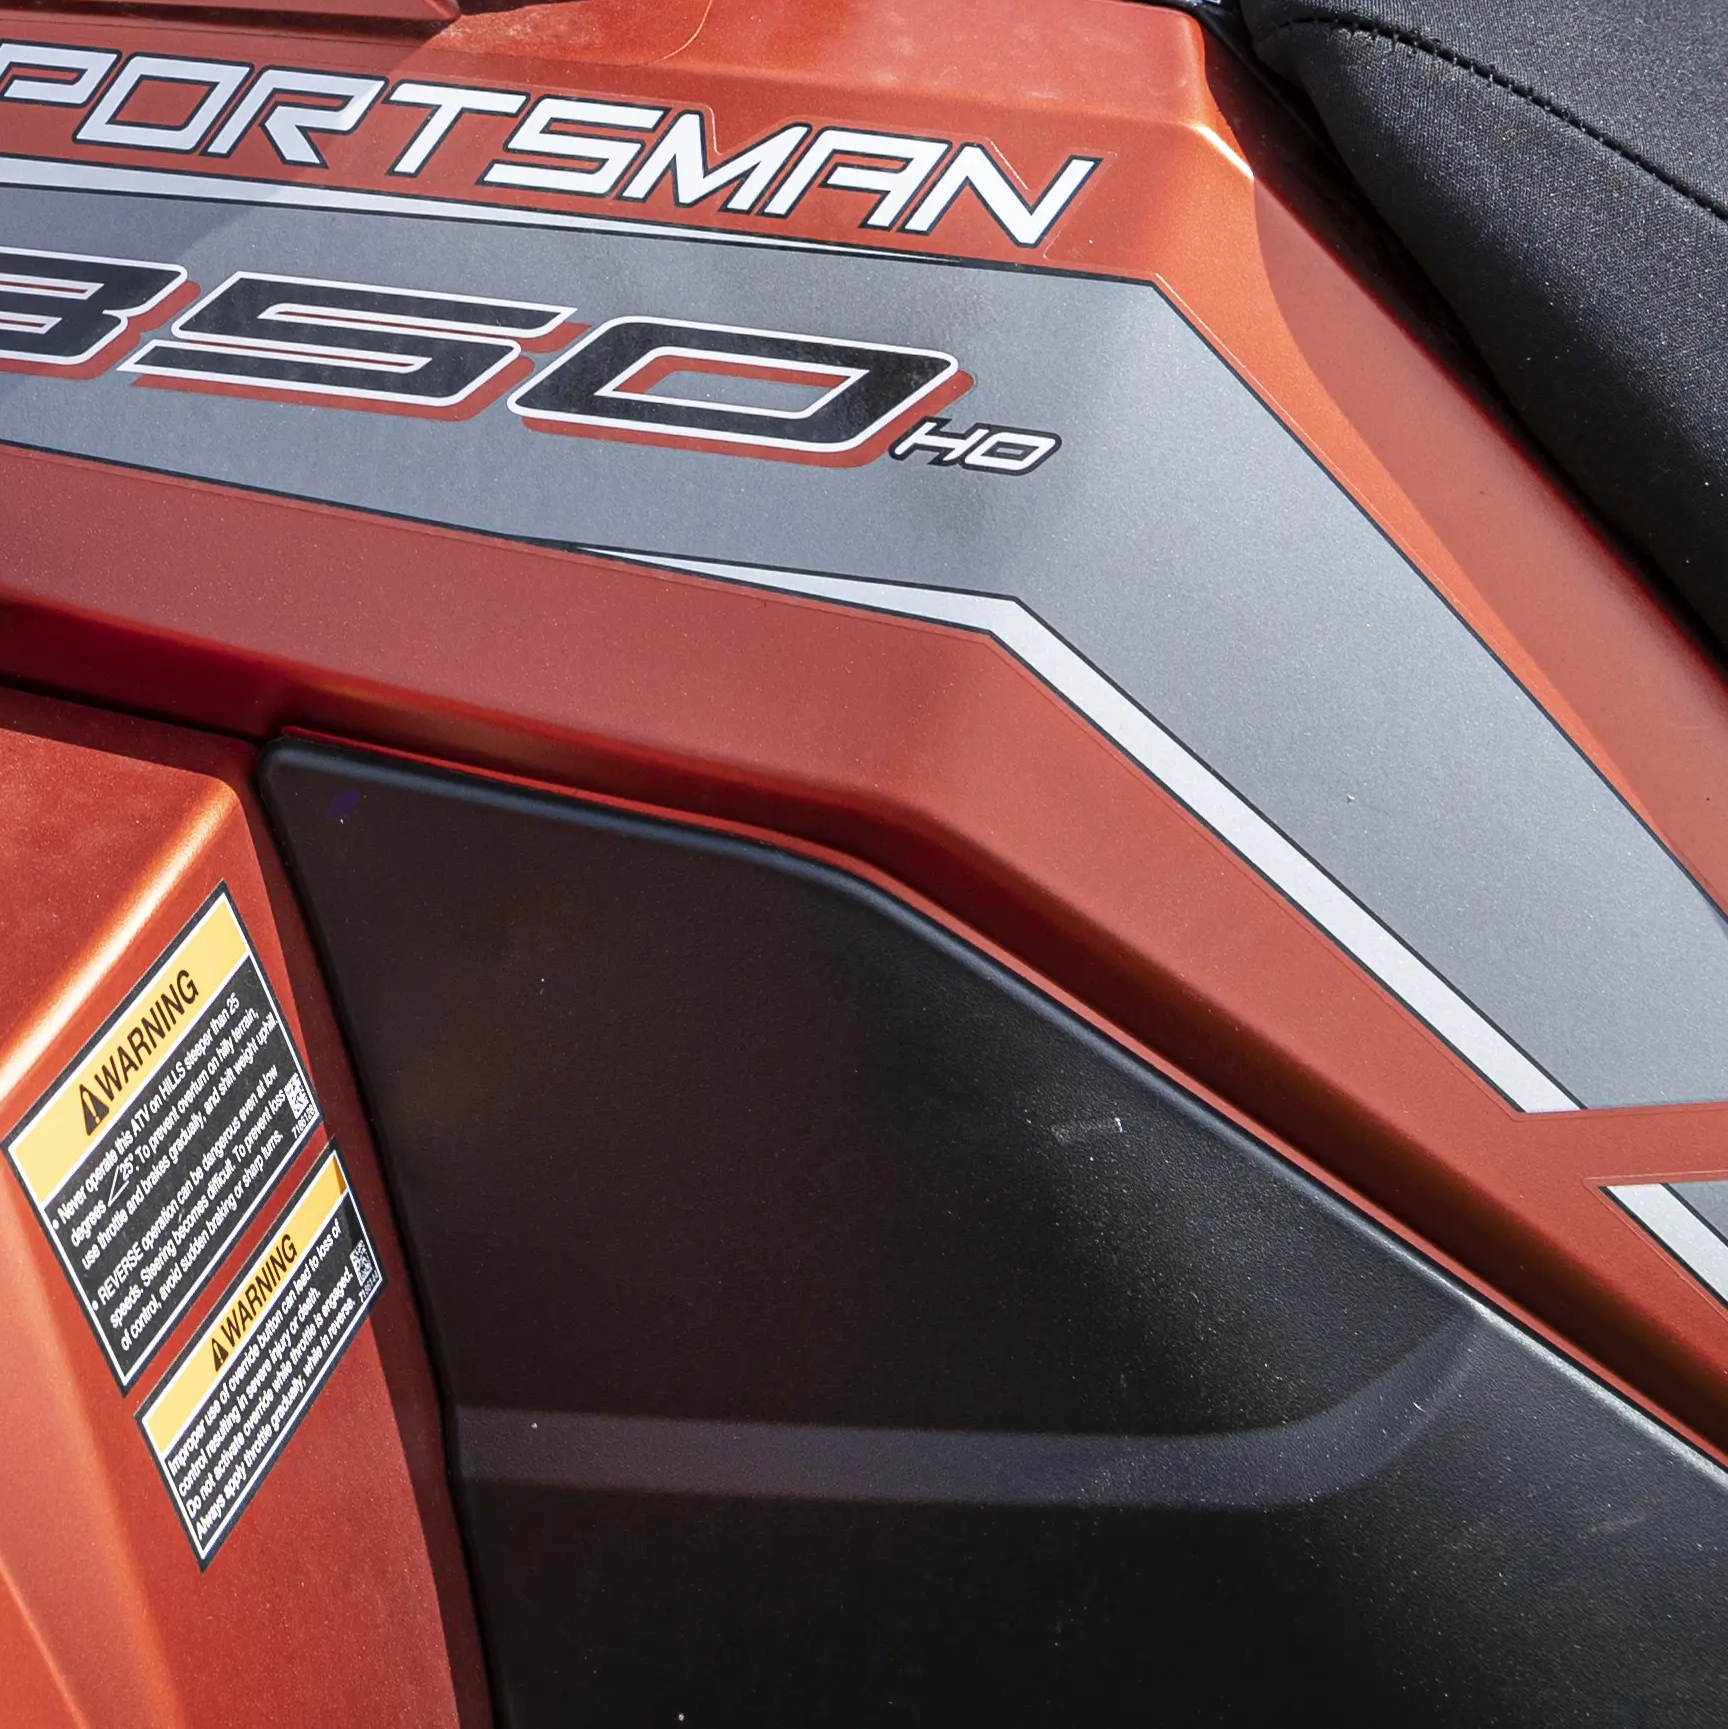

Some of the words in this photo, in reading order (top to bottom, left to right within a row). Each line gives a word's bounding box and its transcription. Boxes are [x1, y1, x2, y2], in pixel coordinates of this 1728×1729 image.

[890, 418, 1061, 475] HO
[58, 1185, 87, 1225] Never
[85, 1149, 118, 1193] operate
[114, 1130, 134, 1155] this
[130, 1103, 150, 1137] ATV
[149, 1094, 163, 1114] on
[158, 1061, 186, 1100] HILLS
[184, 1028, 213, 1070] steeper
[209, 1008, 230, 1035] than
[226, 992, 240, 1015] 25
[70, 1199, 107, 1247] degrees
[135, 1144, 151, 1164] To
[148, 1105, 180, 1154] prevent
[177, 1069, 210, 1114] overturn
[207, 1056, 220, 1075] on
[215, 1036, 234, 1063] hilly
[94, 970, 199, 1101] WARNING
[81, 1244, 101, 1270] use
[96, 1208, 128, 1250] throttle
[126, 1184, 145, 1215] and
[140, 1155, 171, 1195] brakes
[203, 1086, 221, 1115] and
[218, 1067, 237, 1096] shift
[233, 1037, 259, 1075] weight
[97, 1241, 144, 1306] REVERSE
[141, 1199, 179, 1251] operation
[177, 1180, 194, 1205] can
[189, 1166, 204, 1186] be
[202, 1116, 241, 1171] dangerous
[239, 1092, 259, 1122] even
[256, 1079, 267, 1099] at
[262, 1064, 278, 1088] low
[110, 1284, 144, 1328] speeds.
[140, 1238, 177, 1287] Steering
[171, 1194, 209, 1246] becomes
[207, 1158, 236, 1200] difficult.
[231, 1144, 246, 1163] To
[244, 1106, 273, 1153] prevent
[268, 1089, 286, 1115] loss
[121, 1328, 132, 1351] of
[159, 1262, 183, 1301] avoid
[180, 1229, 210, 1272] sudden
[205, 1193, 237, 1236] braking
[233, 1180, 244, 1199] or
[242, 1154, 264, 1188] sharp
[260, 1130, 283, 1160] turns.
[167, 1419, 206, 1477] Improper
[204, 1399, 221, 1426] use
[219, 1382, 230, 1405] of
[228, 1343, 260, 1392] override
[256, 1309, 284, 1349] button
[281, 1289, 297, 1315] can
[293, 1263, 312, 1295] lead
[308, 1255, 319, 1272] to
[316, 1234, 334, 1261] loss
[331, 1218, 341, 1239] of
[178, 1448, 209, 1497] control
[205, 1405, 241, 1459] resulting
[236, 1393, 249, 1412] in
[246, 1358, 272, 1399] severe
[268, 1328, 292, 1365] injury
[289, 1315, 299, 1335] or
[297, 1287, 321, 1322] death.
[186, 1495, 202, 1519] Do
[199, 1472, 216, 1501] not
[213, 1432, 245, 1481] activate
[243, 1388, 274, 1437] override
[271, 1360, 293, 1393] while
[289, 1323, 317, 1365] throttle
[313, 1312, 324, 1329] is
[321, 1266, 353, 1318] engaged.
[220, 1234, 297, 1347] WARNING
[196, 1493, 226, 1541] Always
[223, 1461, 247, 1500] apply
[243, 1423, 273, 1468] throttle
[303, 1345, 323, 1377] while
[319, 1334, 331, 1351] in
[327, 1297, 356, 1340] reverse.
